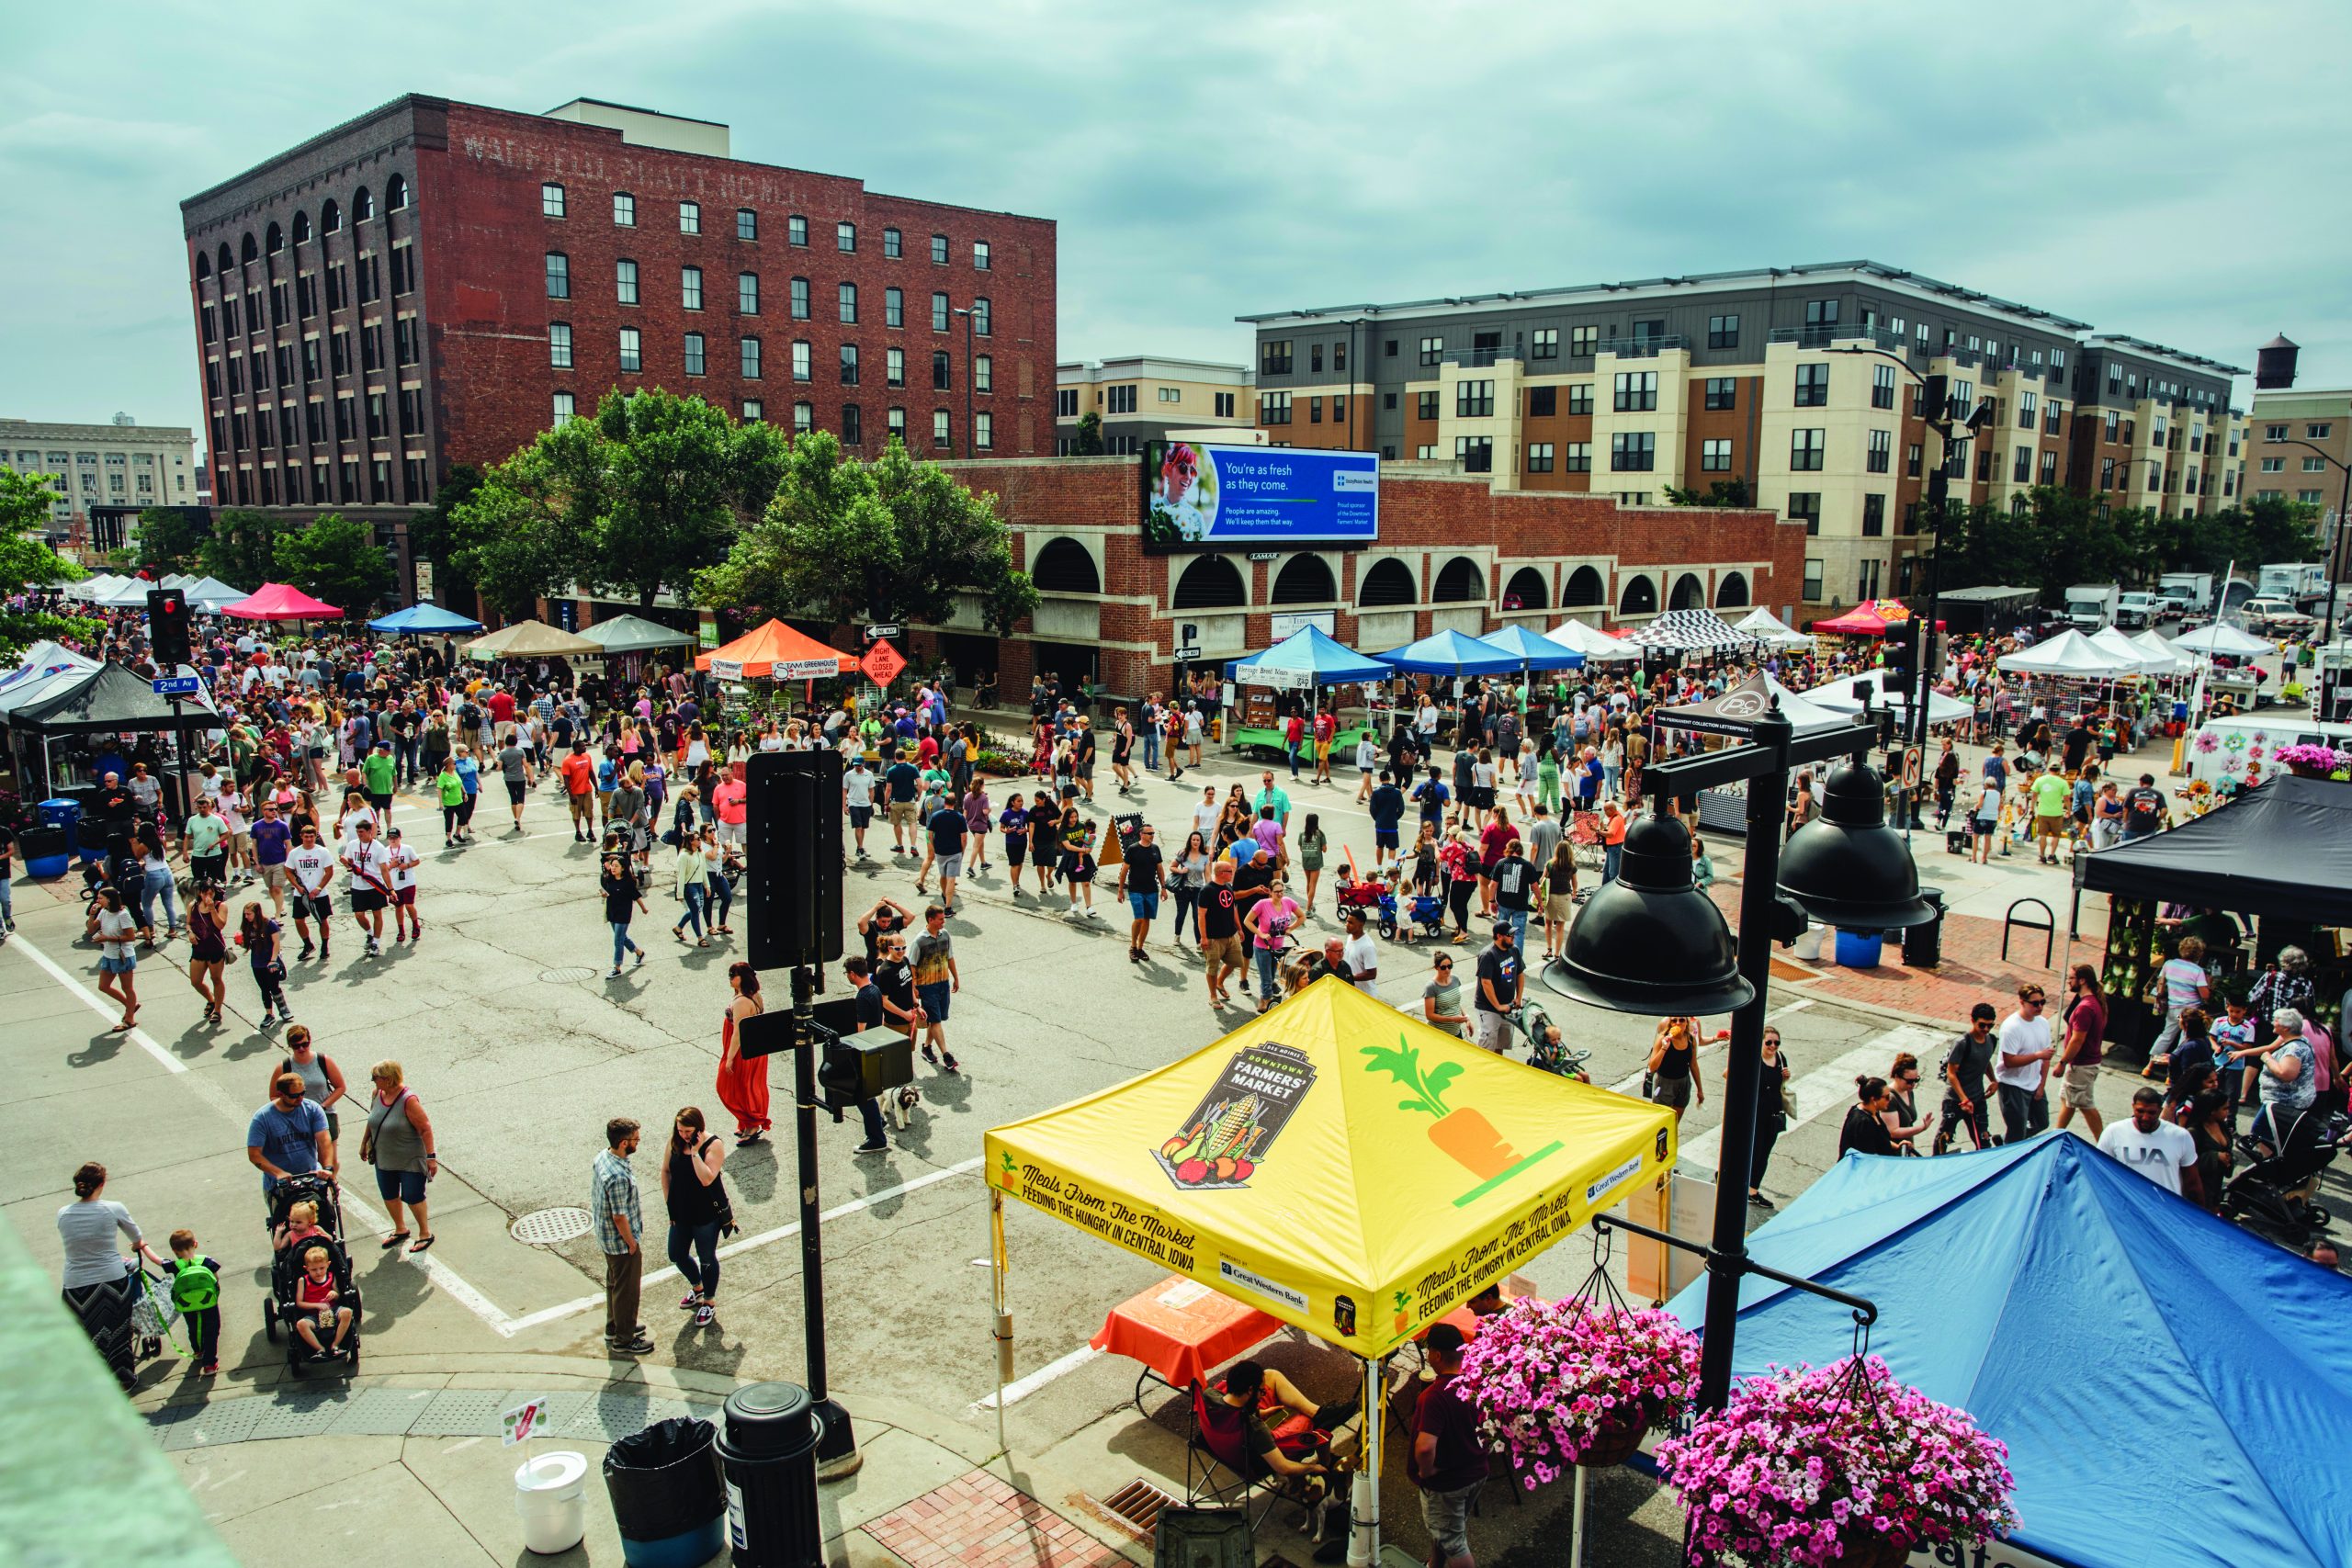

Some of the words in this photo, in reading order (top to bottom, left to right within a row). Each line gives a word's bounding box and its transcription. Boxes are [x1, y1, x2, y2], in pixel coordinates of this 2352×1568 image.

[1226, 463, 1255, 475] You're
[1257, 466, 1268, 475] as
[1270, 463, 1293, 476] fresh
[1226, 480, 1237, 490] as
[1238, 478, 1259, 493] they
[1261, 481, 1288, 491] come.
[1226, 507, 1246, 516] People
[1240, 518, 1255, 527] keep
[1282, 519, 1294, 527] way.
[804, 660, 838, 669] GREENHOUSE
[160, 680, 177, 692] 2nd
[1297, 678, 1309, 687] gap
[1692, 720, 1719, 728] COLLECTION
[1719, 724, 1749, 733] LETTERPRESS
[298, 858, 319, 869] TIGER
[1266, 1044, 1278, 1053] DES
[1279, 1047, 1301, 1058] MOINES
[1248, 1055, 1304, 1075] DOWNTOWN
[1233, 1061, 1306, 1089] FARMERS'
[1231, 1073, 1294, 1099] MARKET
[2122, 1146, 2170, 1167] UA
[1595, 1179, 1610, 1192] Great
[1610, 1168, 1629, 1185] Western
[1022, 1164, 1060, 1194] Meals
[1064, 1183, 1106, 1213] From
[1110, 1201, 1137, 1225] The
[1140, 1214, 1196, 1251] Market
[1022, 1185, 1057, 1212] FEEDING
[1057, 1200, 1074, 1220] THE
[1075, 1208, 1112, 1236] HUNGRY
[1112, 1224, 1124, 1242] IN
[1124, 1229, 1165, 1260] CENTRAL
[1169, 1247, 1194, 1273] IOWA
[1417, 1260, 1457, 1300] Meals
[1461, 1237, 1499, 1273] From
[1503, 1220, 1527, 1247] The
[1529, 1187, 1573, 1228] Market
[1419, 1288, 1454, 1321] FEEDING
[1455, 1274, 1472, 1296] THE
[1473, 1251, 1505, 1286] HUNGRY
[1506, 1247, 1516, 1264] IN
[1516, 1227, 1551, 1257] CENTRAL
[1552, 1211, 1572, 1235] IOWA
[1233, 1269, 1253, 1284] Great
[1253, 1278, 1283, 1297] Western
[1284, 1291, 1304, 1306] Bank
